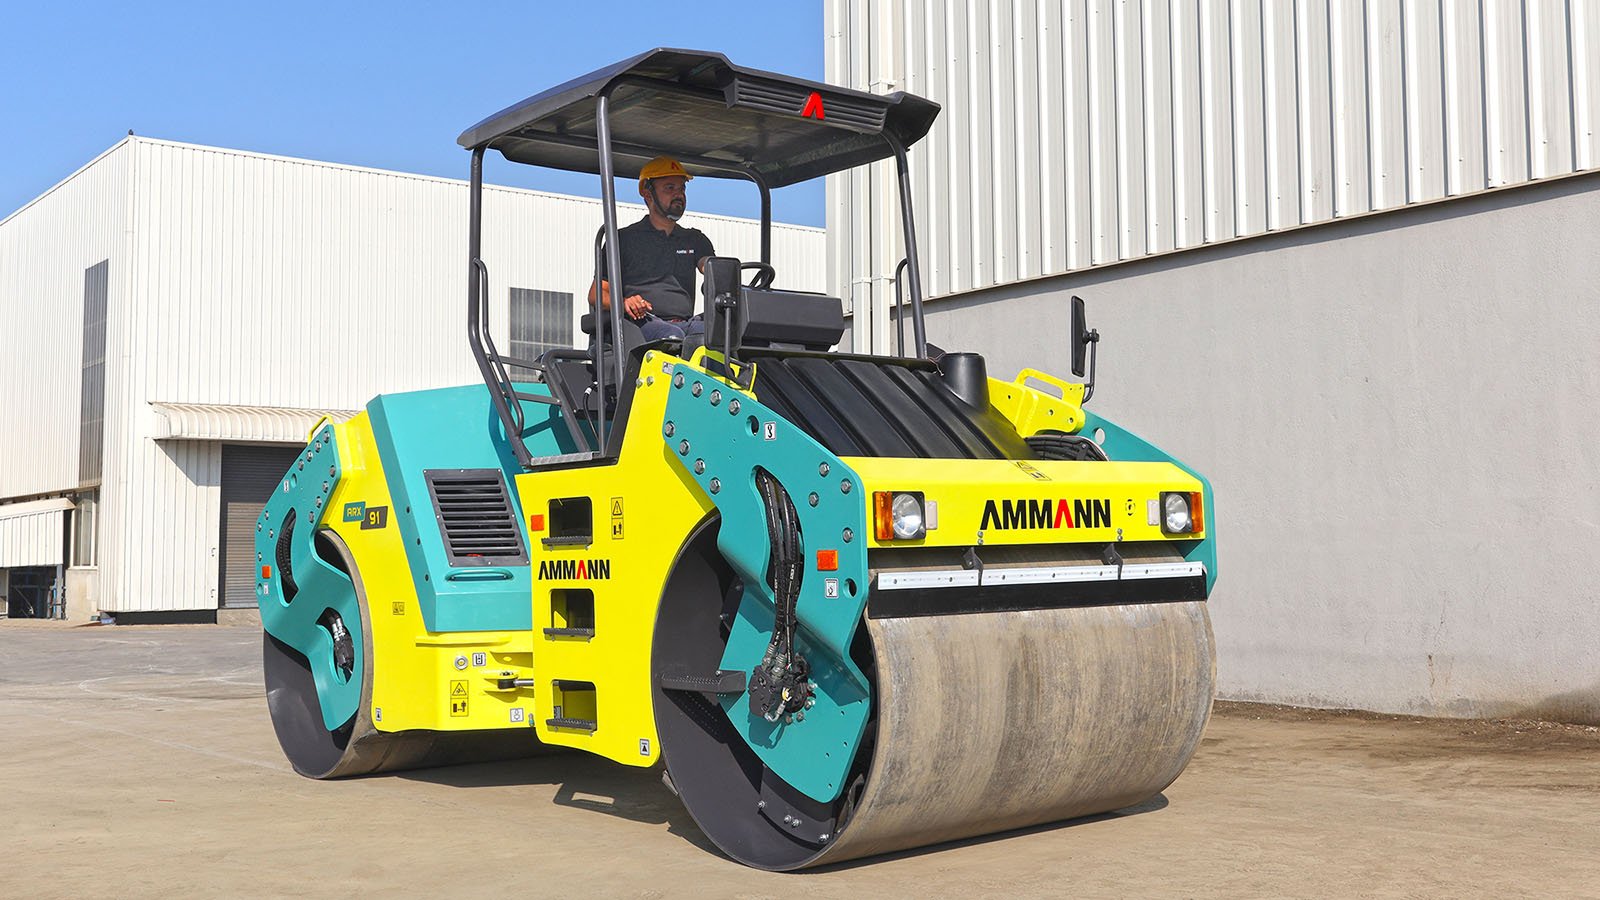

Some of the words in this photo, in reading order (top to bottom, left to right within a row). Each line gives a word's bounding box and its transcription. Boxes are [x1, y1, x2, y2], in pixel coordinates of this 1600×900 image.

[347, 506, 362, 517] ARX
[369, 511, 380, 525] 91
[979, 499, 1111, 530] AMMANN
[538, 559, 610, 580] AMMANN
